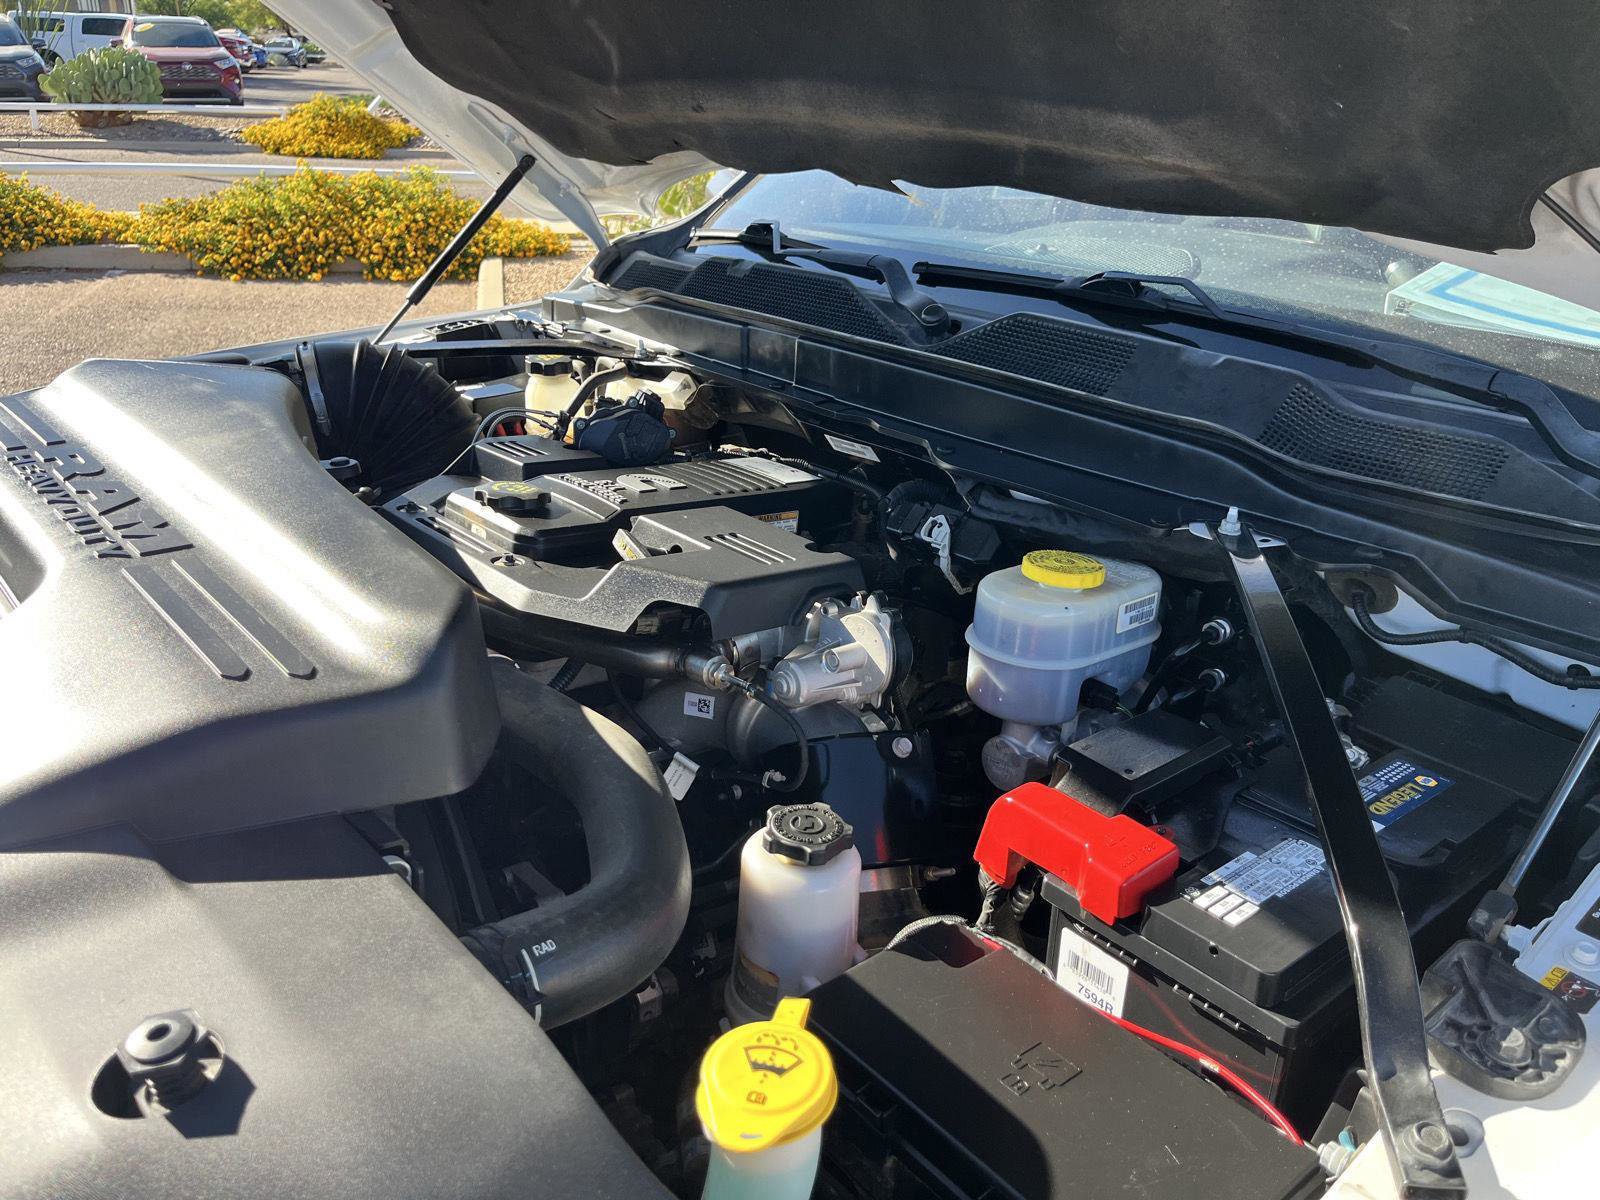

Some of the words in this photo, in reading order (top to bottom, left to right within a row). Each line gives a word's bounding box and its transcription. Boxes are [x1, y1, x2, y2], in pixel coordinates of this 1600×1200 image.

[4, 450, 79, 505] HEAVY
[53, 505, 133, 559] DUTY
[34, 444, 195, 557] RAM
[1369, 782, 1426, 815] LEGEND
[532, 939, 557, 957] RAD
[1077, 982, 1114, 1014] 7594R
